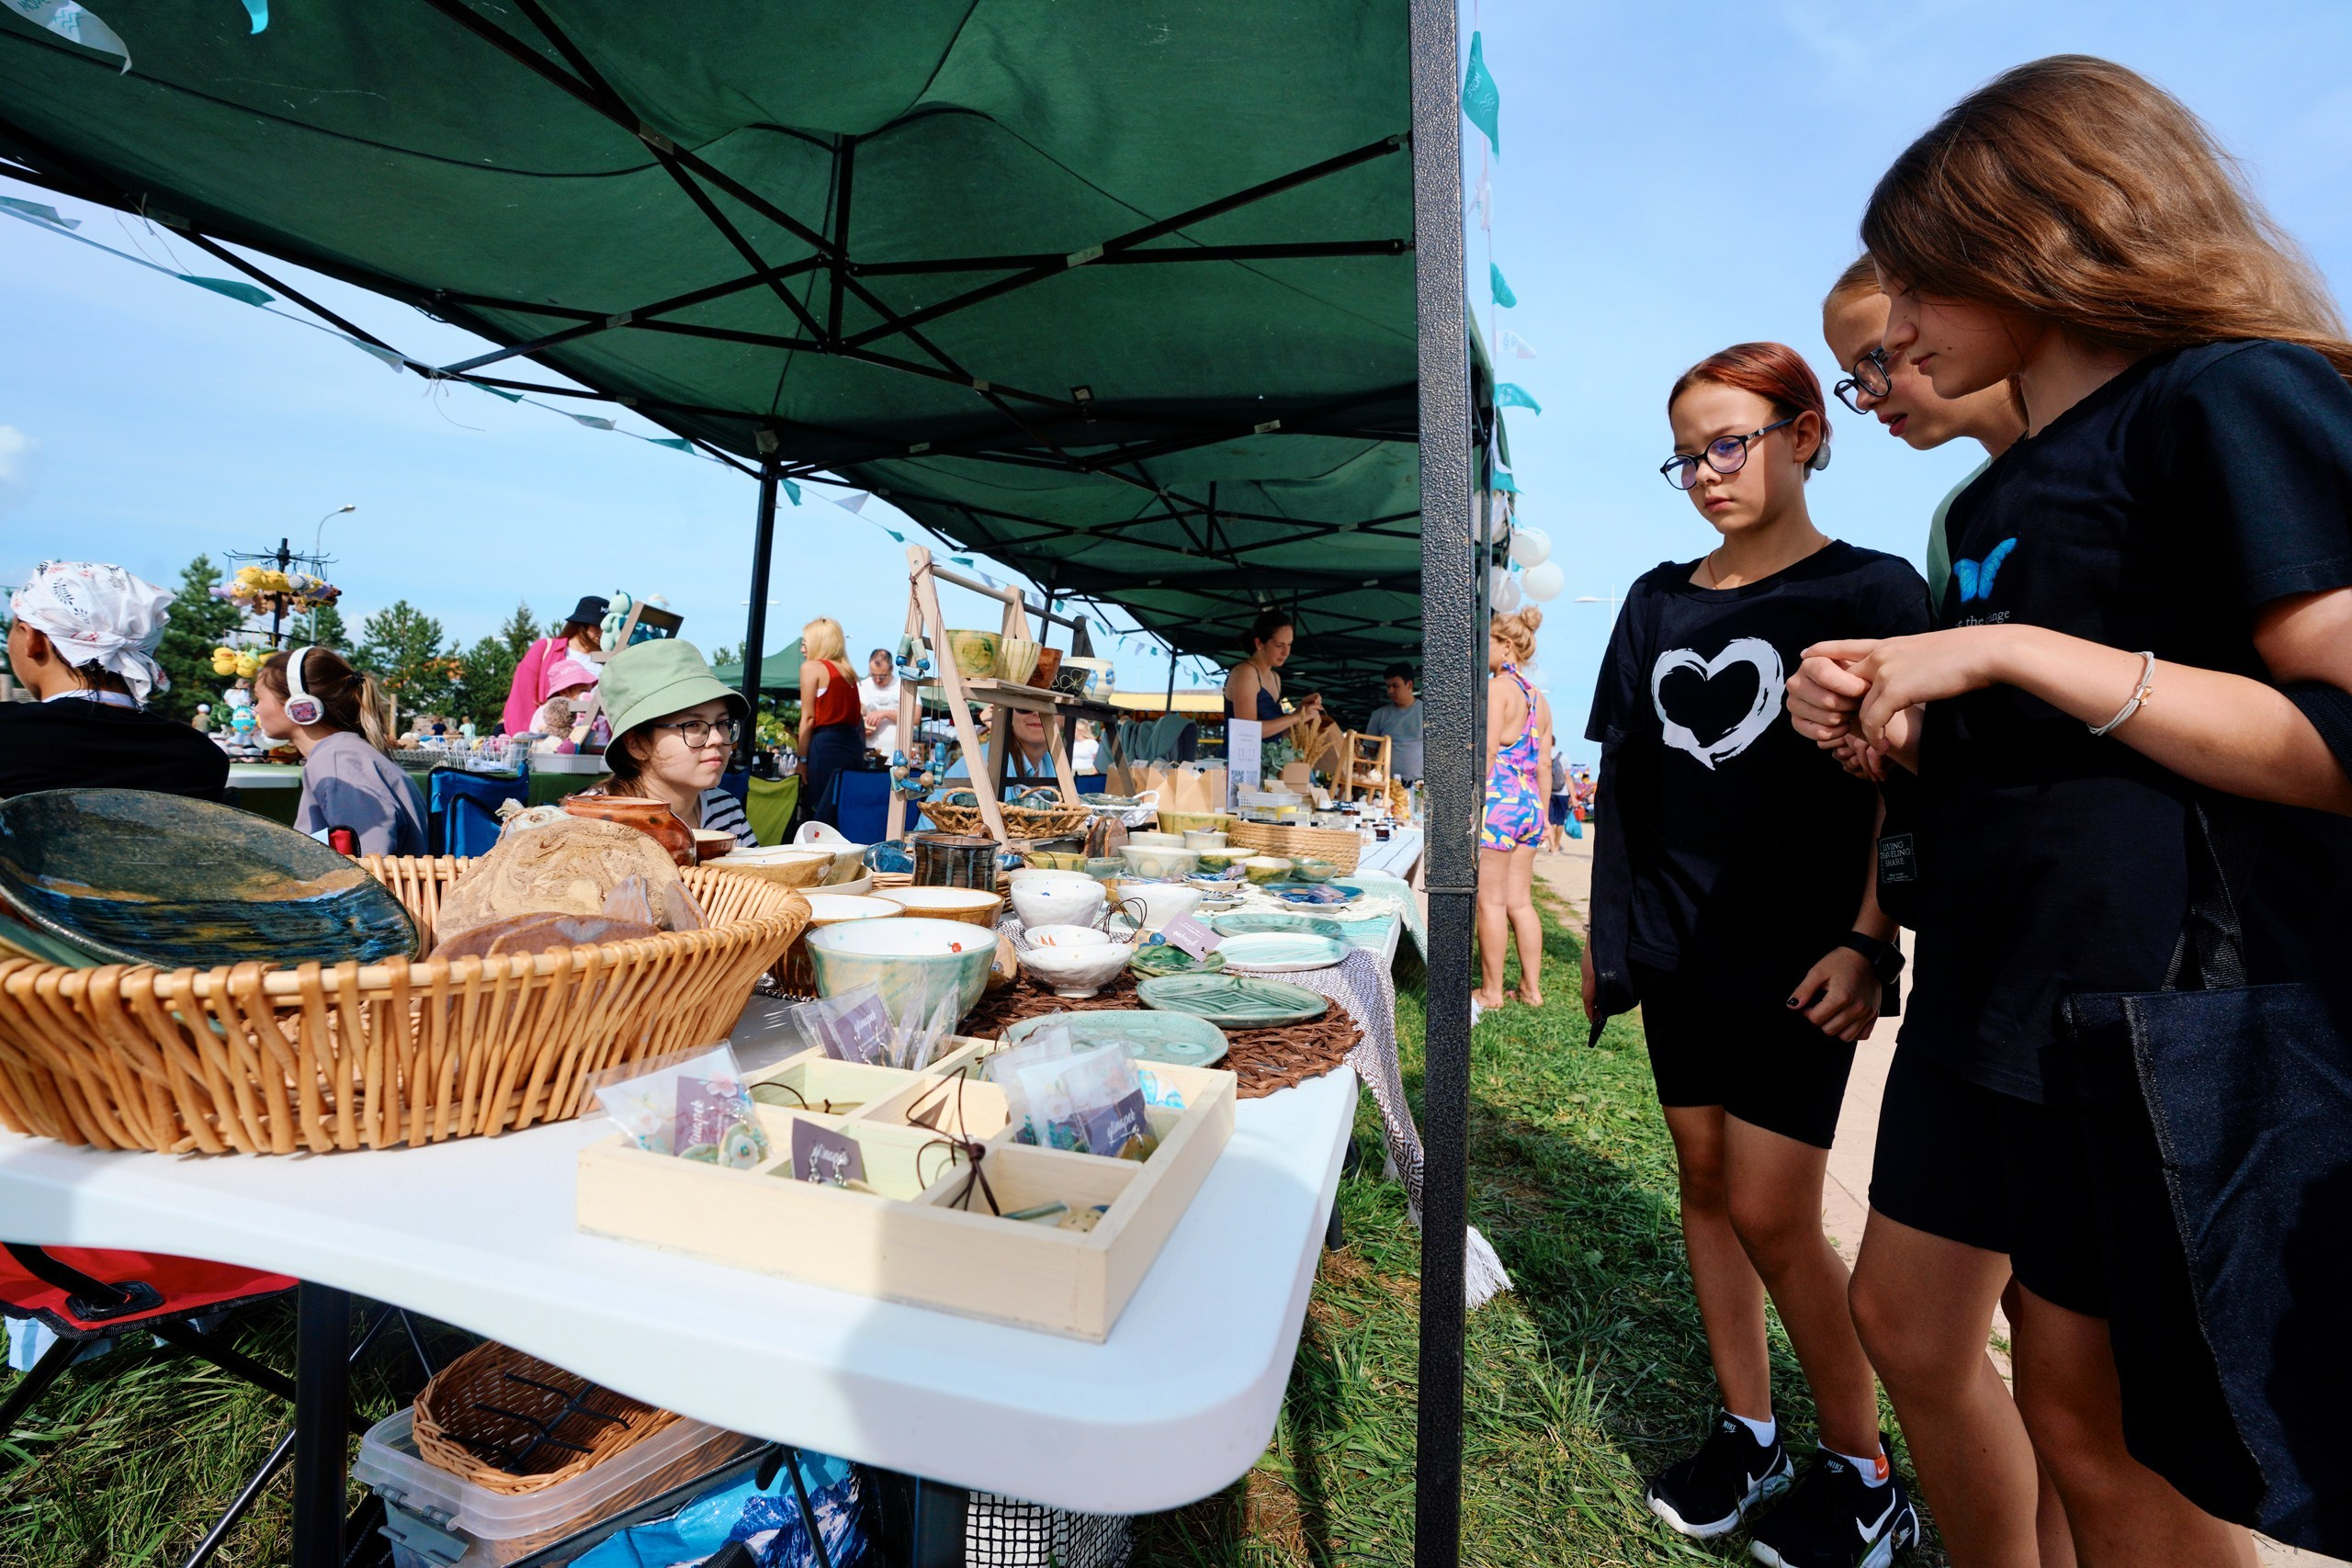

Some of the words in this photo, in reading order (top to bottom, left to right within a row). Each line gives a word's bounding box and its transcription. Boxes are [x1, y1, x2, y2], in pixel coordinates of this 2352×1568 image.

[1966, 615, 1984, 626] the
[1883, 840, 1904, 851] LIVING
[1885, 857, 1905, 867] SHARE
[1723, 1420, 1737, 1432] NIKE
[1826, 1460, 1844, 1471] NIKE
